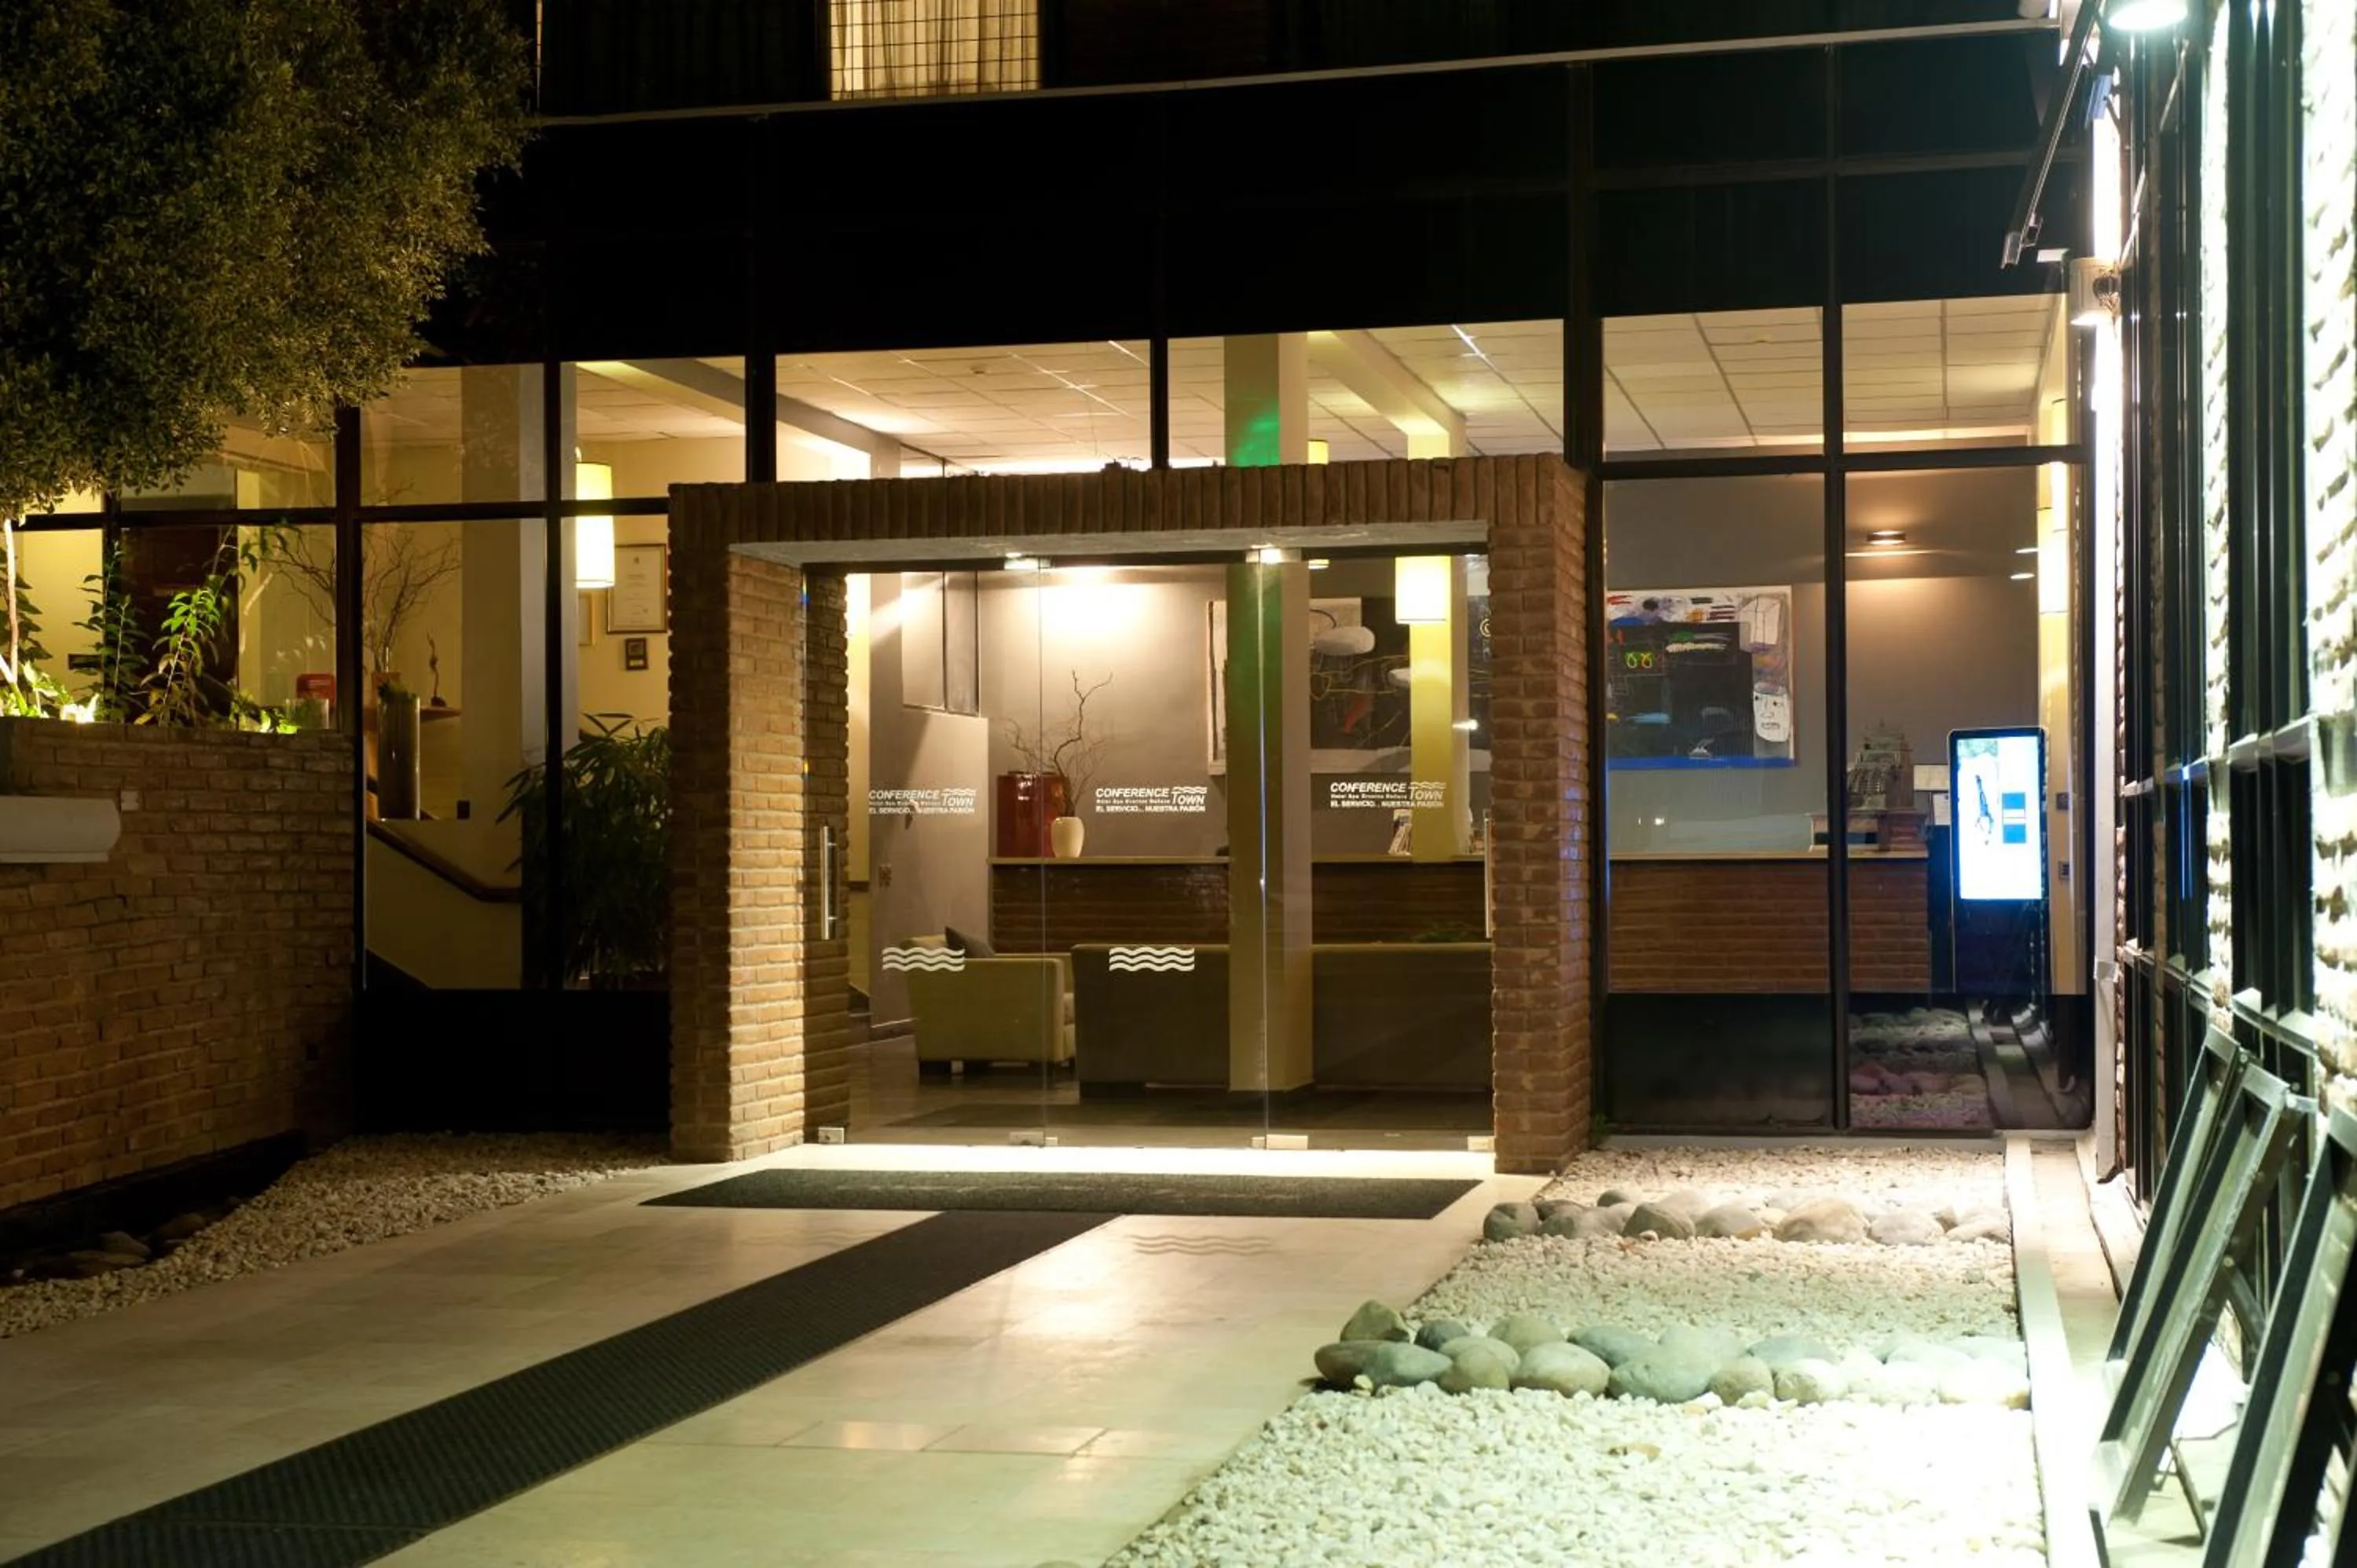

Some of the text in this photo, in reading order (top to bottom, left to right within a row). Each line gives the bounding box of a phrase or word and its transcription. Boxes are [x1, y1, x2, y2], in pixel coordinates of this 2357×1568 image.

[868, 789, 940, 800] CONFERENCE
[942, 792, 973, 806] TOWN
[1095, 788, 1204, 804] CONFERENCE TOWN
[1330, 782, 1443, 800] CONFERENCE TOWN
